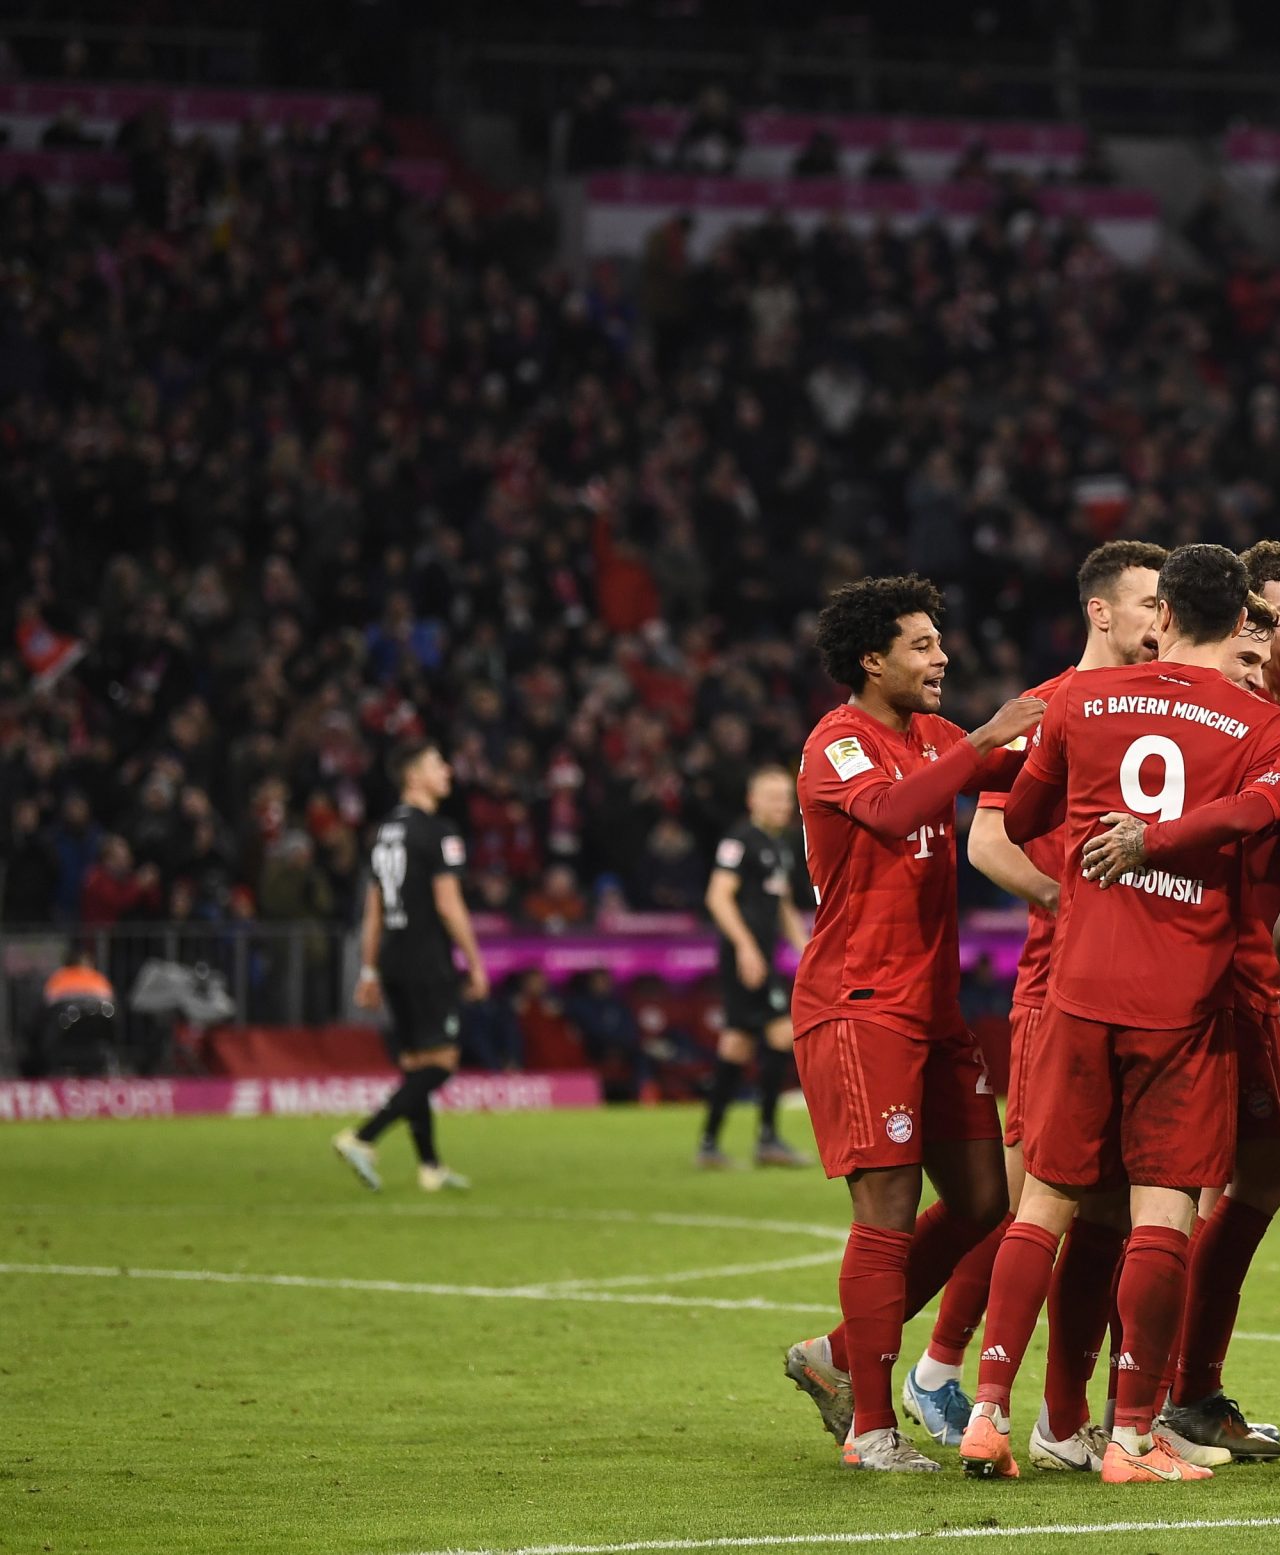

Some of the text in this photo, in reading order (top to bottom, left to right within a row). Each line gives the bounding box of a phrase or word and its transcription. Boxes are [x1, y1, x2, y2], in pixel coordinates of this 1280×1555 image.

[1084, 696, 1249, 740] FC BAYERN MÜNCHEN
[1119, 734, 1185, 824] 9
[1082, 866, 1204, 905] NDOWSKI
[270, 1077, 402, 1114] MAGEN
